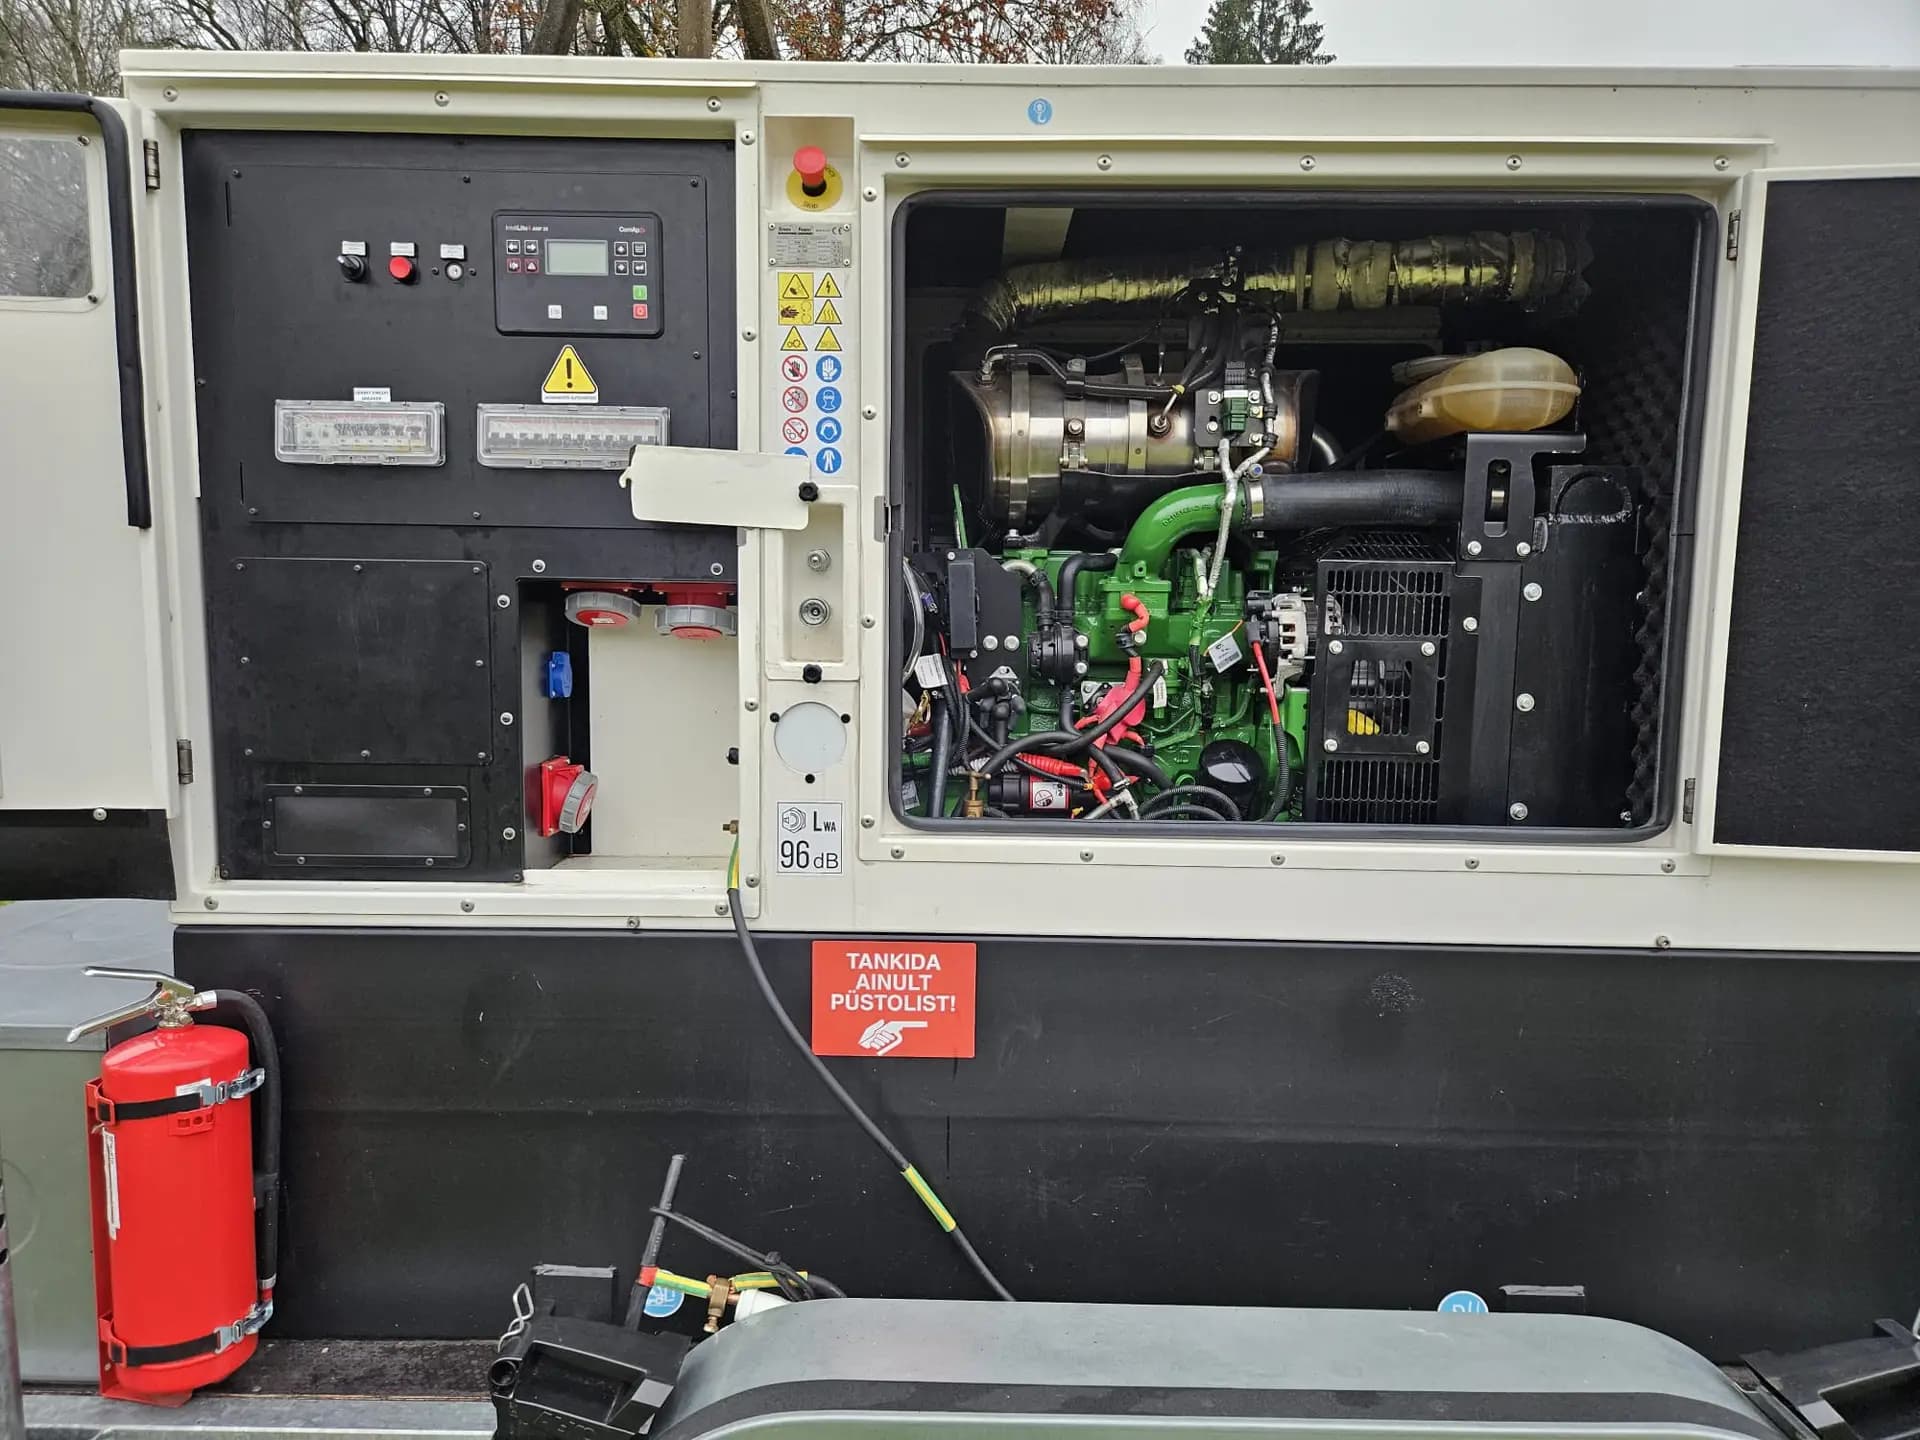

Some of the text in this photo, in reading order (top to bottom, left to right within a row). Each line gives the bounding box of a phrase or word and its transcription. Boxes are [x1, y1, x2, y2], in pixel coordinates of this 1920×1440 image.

[780, 840, 839, 869] 96 dB
[846, 953, 942, 971] TANKIDA
[856, 973, 932, 991] AINULT
[830, 989, 956, 1012] PÜSTOLIST!
